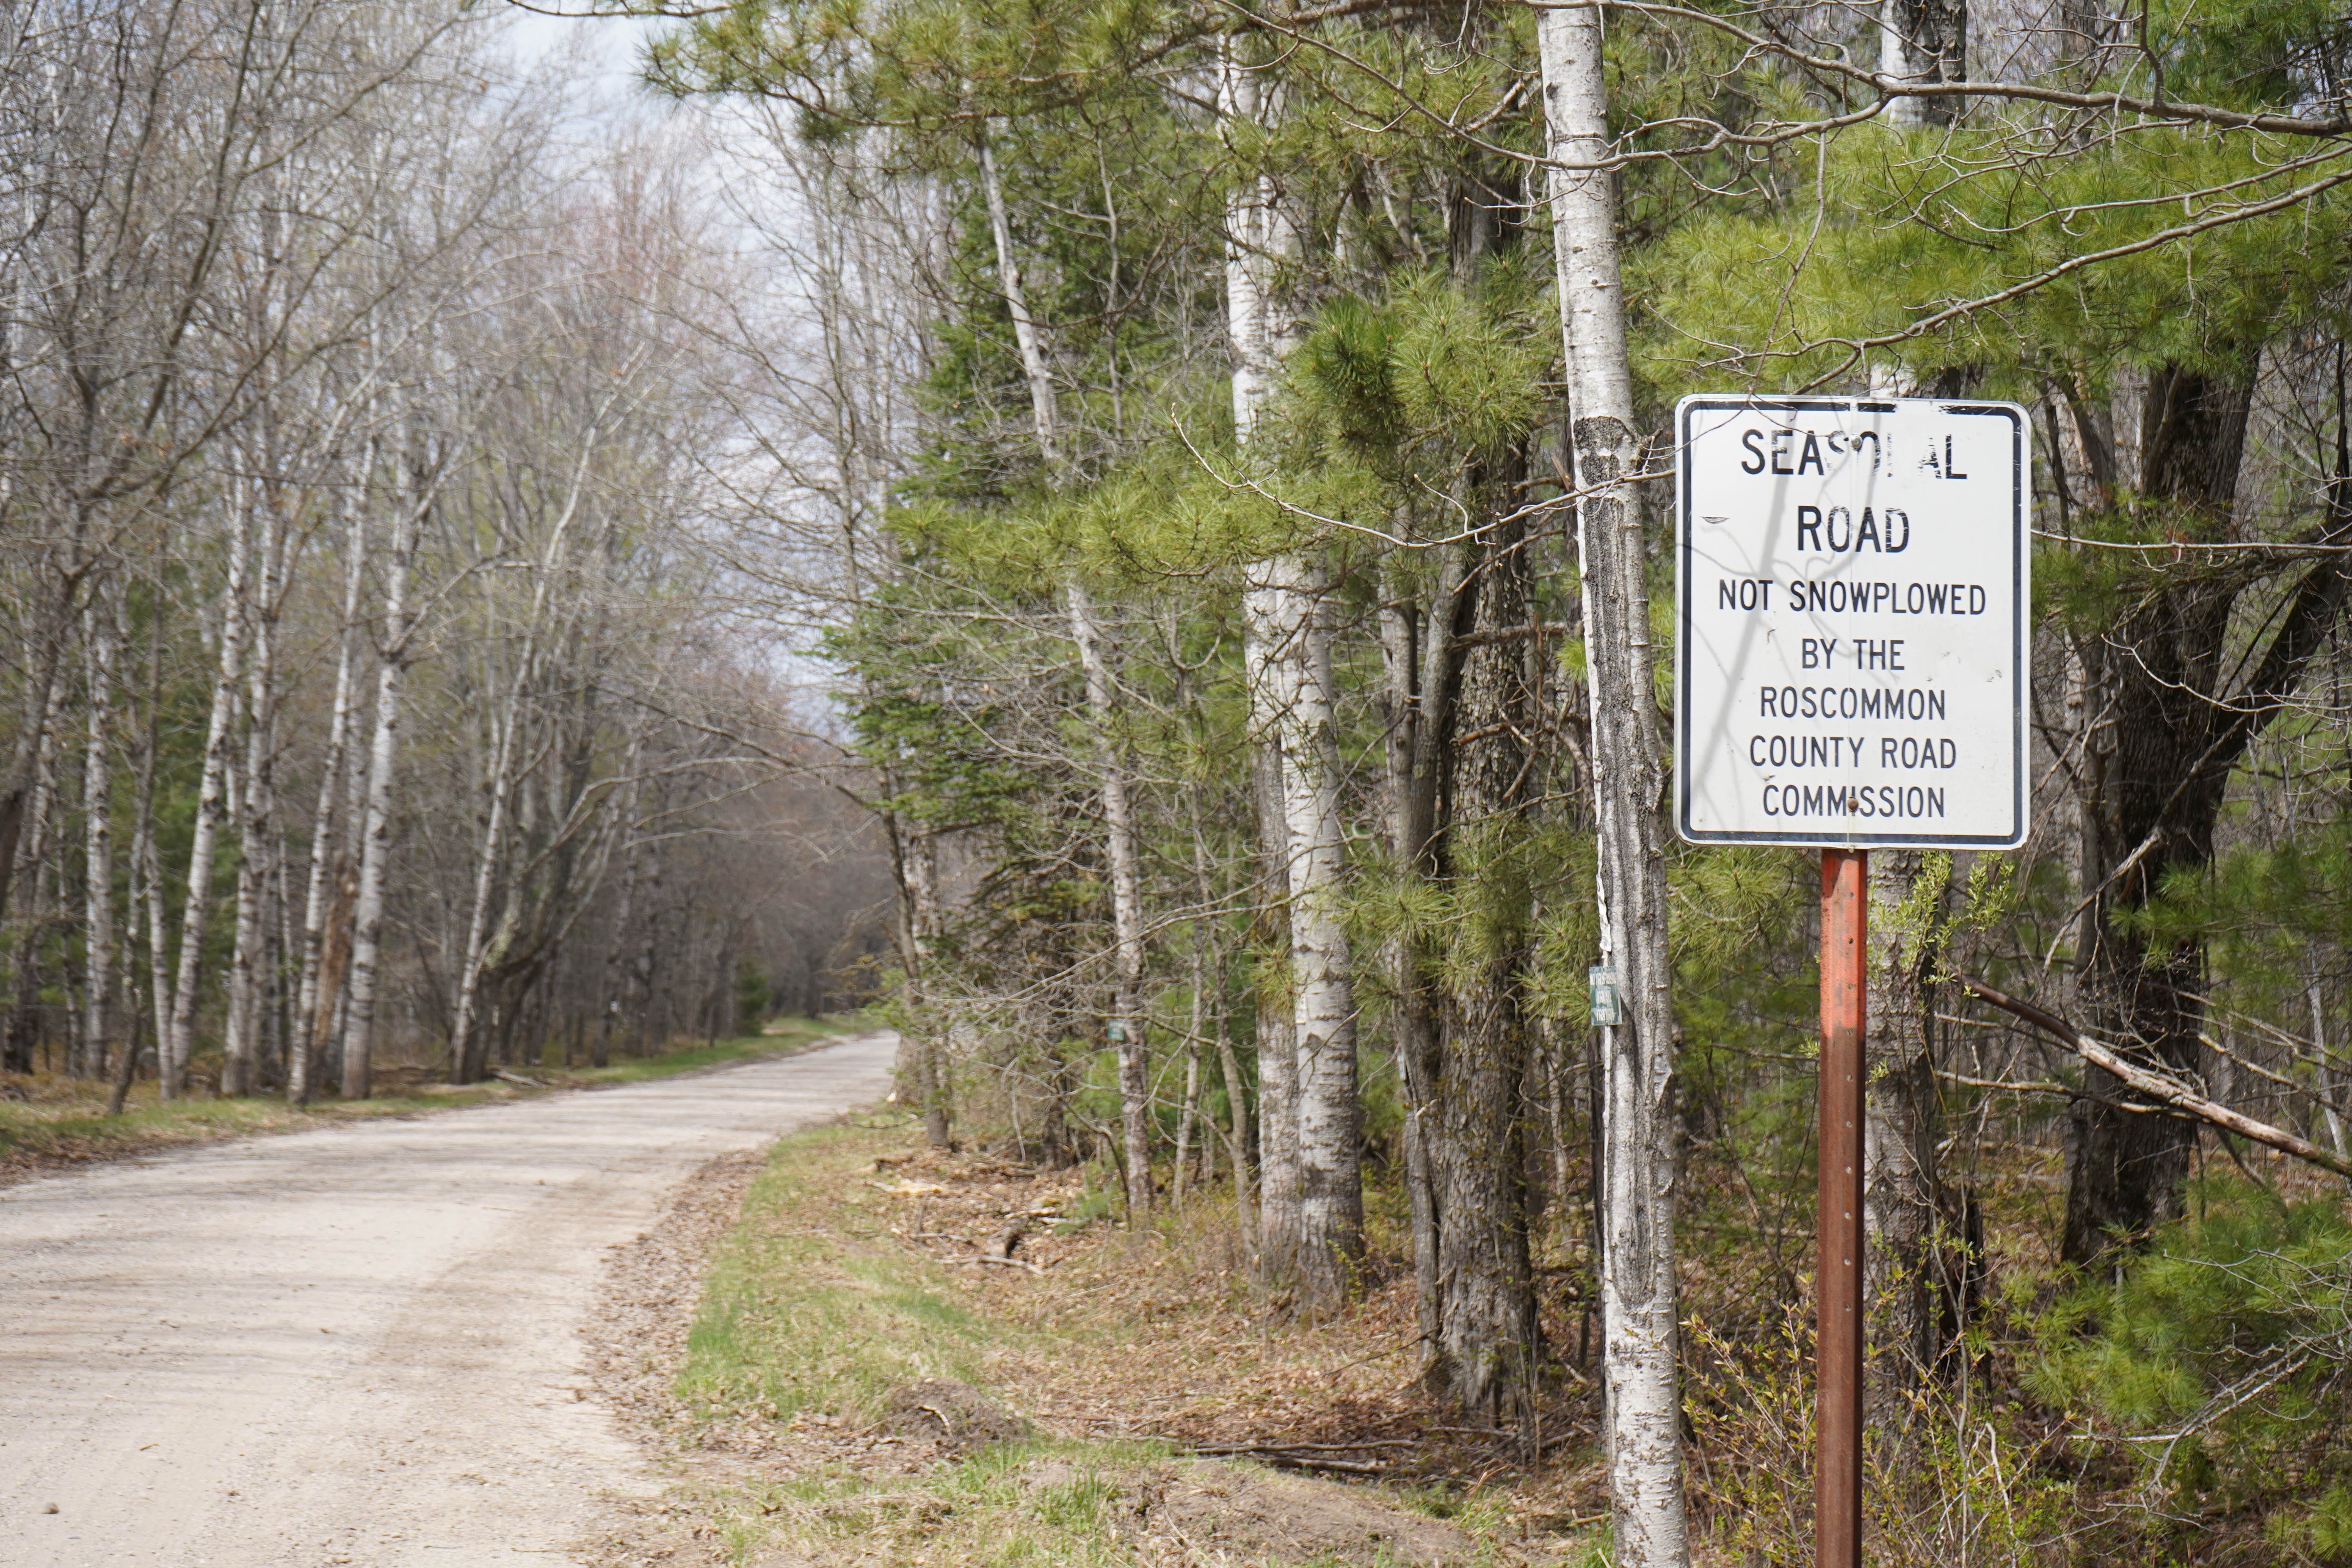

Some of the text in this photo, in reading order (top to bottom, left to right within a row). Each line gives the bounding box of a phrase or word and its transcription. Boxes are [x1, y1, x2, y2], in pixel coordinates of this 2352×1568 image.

[1798, 506, 1909, 553] ROAD
[1719, 579, 1985, 615] NOT SNOWPLOWED
[1802, 638, 1905, 670] BY THE
[1761, 686, 1945, 720] ROSCOMMON
[1750, 735, 1956, 769] COUNTY ROAD
